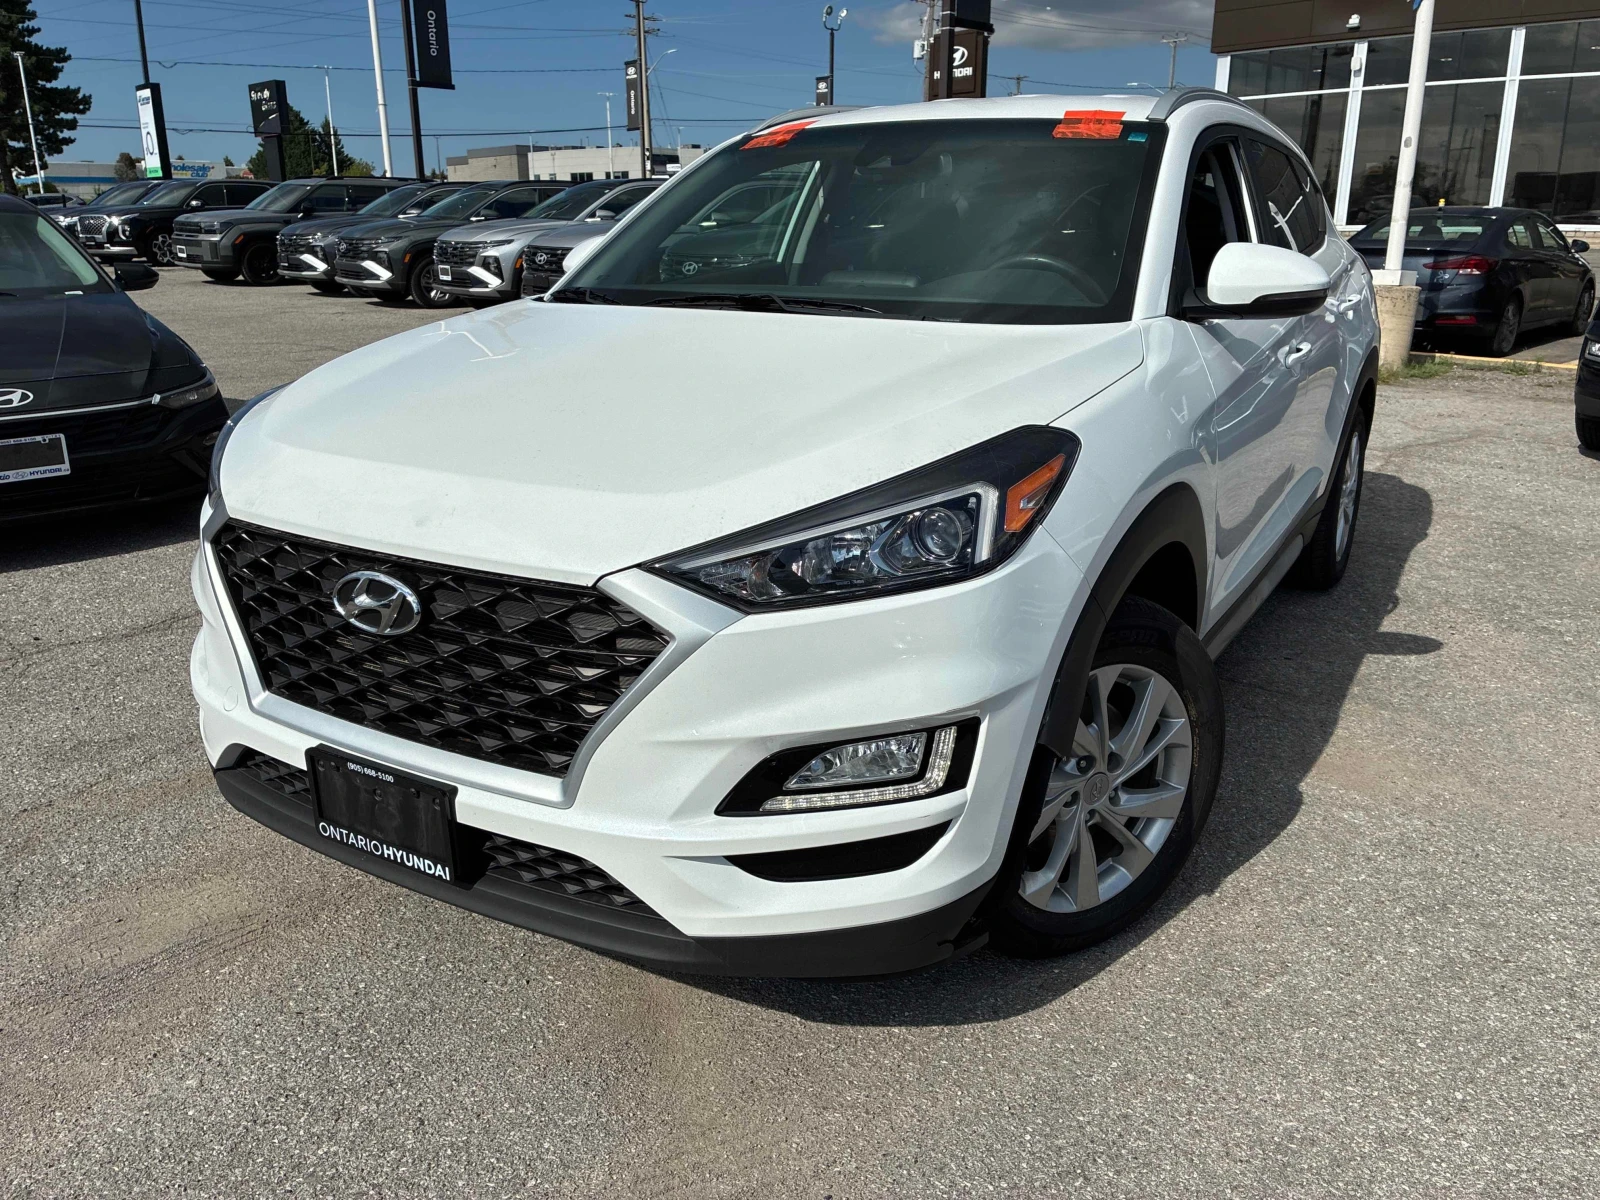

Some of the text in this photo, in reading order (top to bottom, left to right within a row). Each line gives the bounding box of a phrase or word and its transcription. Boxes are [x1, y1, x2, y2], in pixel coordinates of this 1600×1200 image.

[427, 10, 439, 56] Ontario
[934, 67, 973, 80] HNDAI
[30, 467, 62, 476] HYUNDAI
[347, 761, 394, 783] (905) 668-5100
[319, 822, 450, 881] ONTARIO HYUNDAI
